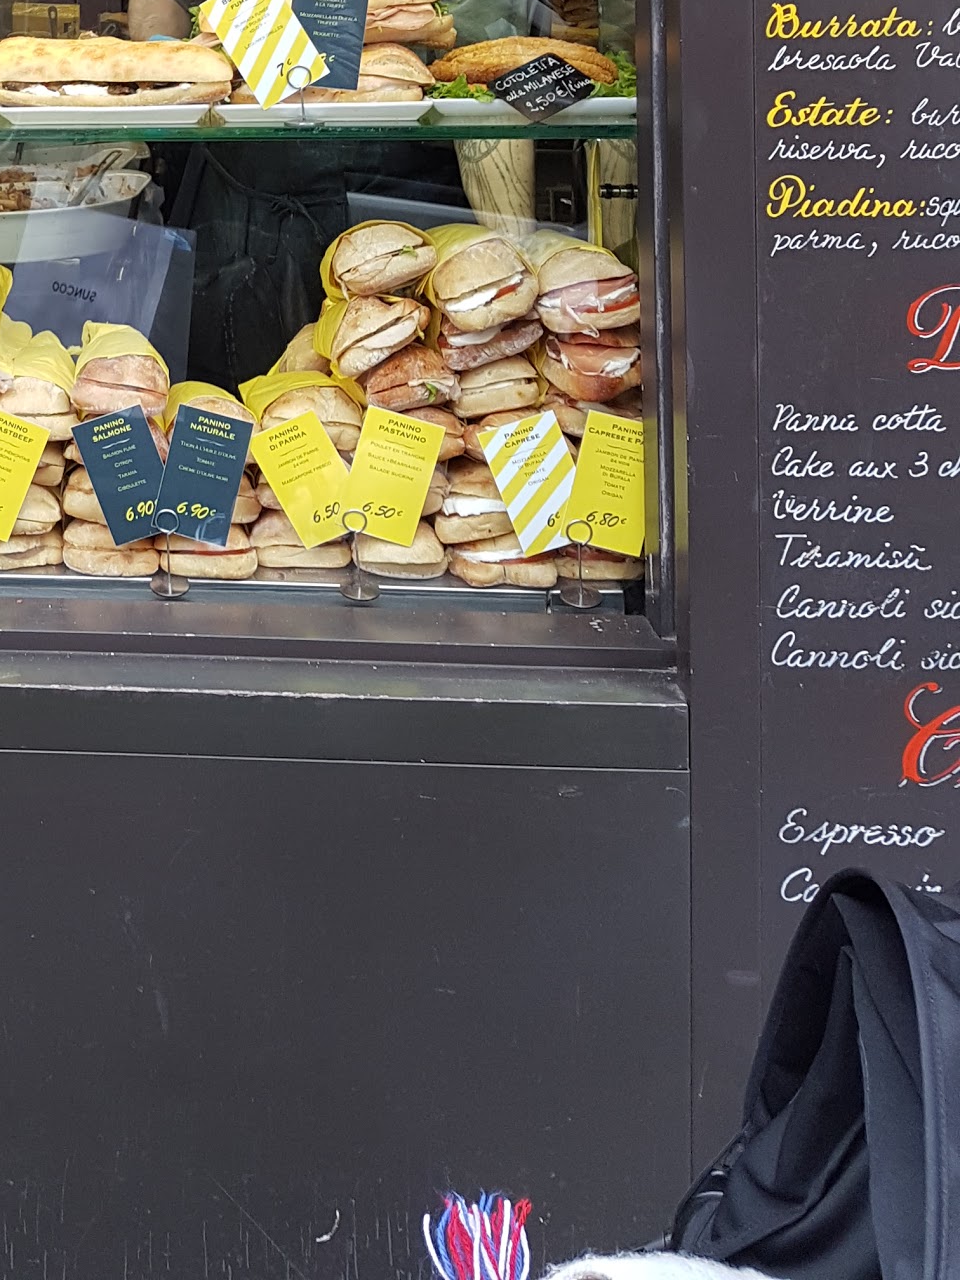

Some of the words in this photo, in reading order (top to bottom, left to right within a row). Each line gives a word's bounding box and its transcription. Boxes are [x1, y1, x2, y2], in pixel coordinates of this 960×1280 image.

[767, 45, 897, 72] bresaola
[495, 56, 560, 91] COTOLETTA
[523, 63, 576, 94] MILANESE
[768, 135, 887, 168] riserva,
[770, 230, 878, 257] parma,
[93, 418, 124, 433] PANINO
[198, 415, 231, 430] PANINO
[388, 418, 422, 434] PANINO
[772, 403, 859, 433] Panna
[872, 404, 947, 432] cotta
[92, 424, 132, 442] SALMONE
[189, 422, 236, 441] NATURALE
[268, 424, 299, 442] PANINO
[279, 431, 307, 447] PARMA
[378, 424, 427, 444] PASTAVINO
[504, 426, 534, 439] PANINO
[504, 433, 540, 449] CAPRESE
[588, 427, 626, 442] CAPRESE
[771, 446, 835, 478] Cake
[848, 460, 899, 479] aux
[908, 451, 930, 478] 3
[772, 489, 895, 524] Verrine
[776, 584, 911, 620] Cannoli
[771, 631, 907, 670] Cannoli
[778, 807, 946, 856] Espresso
